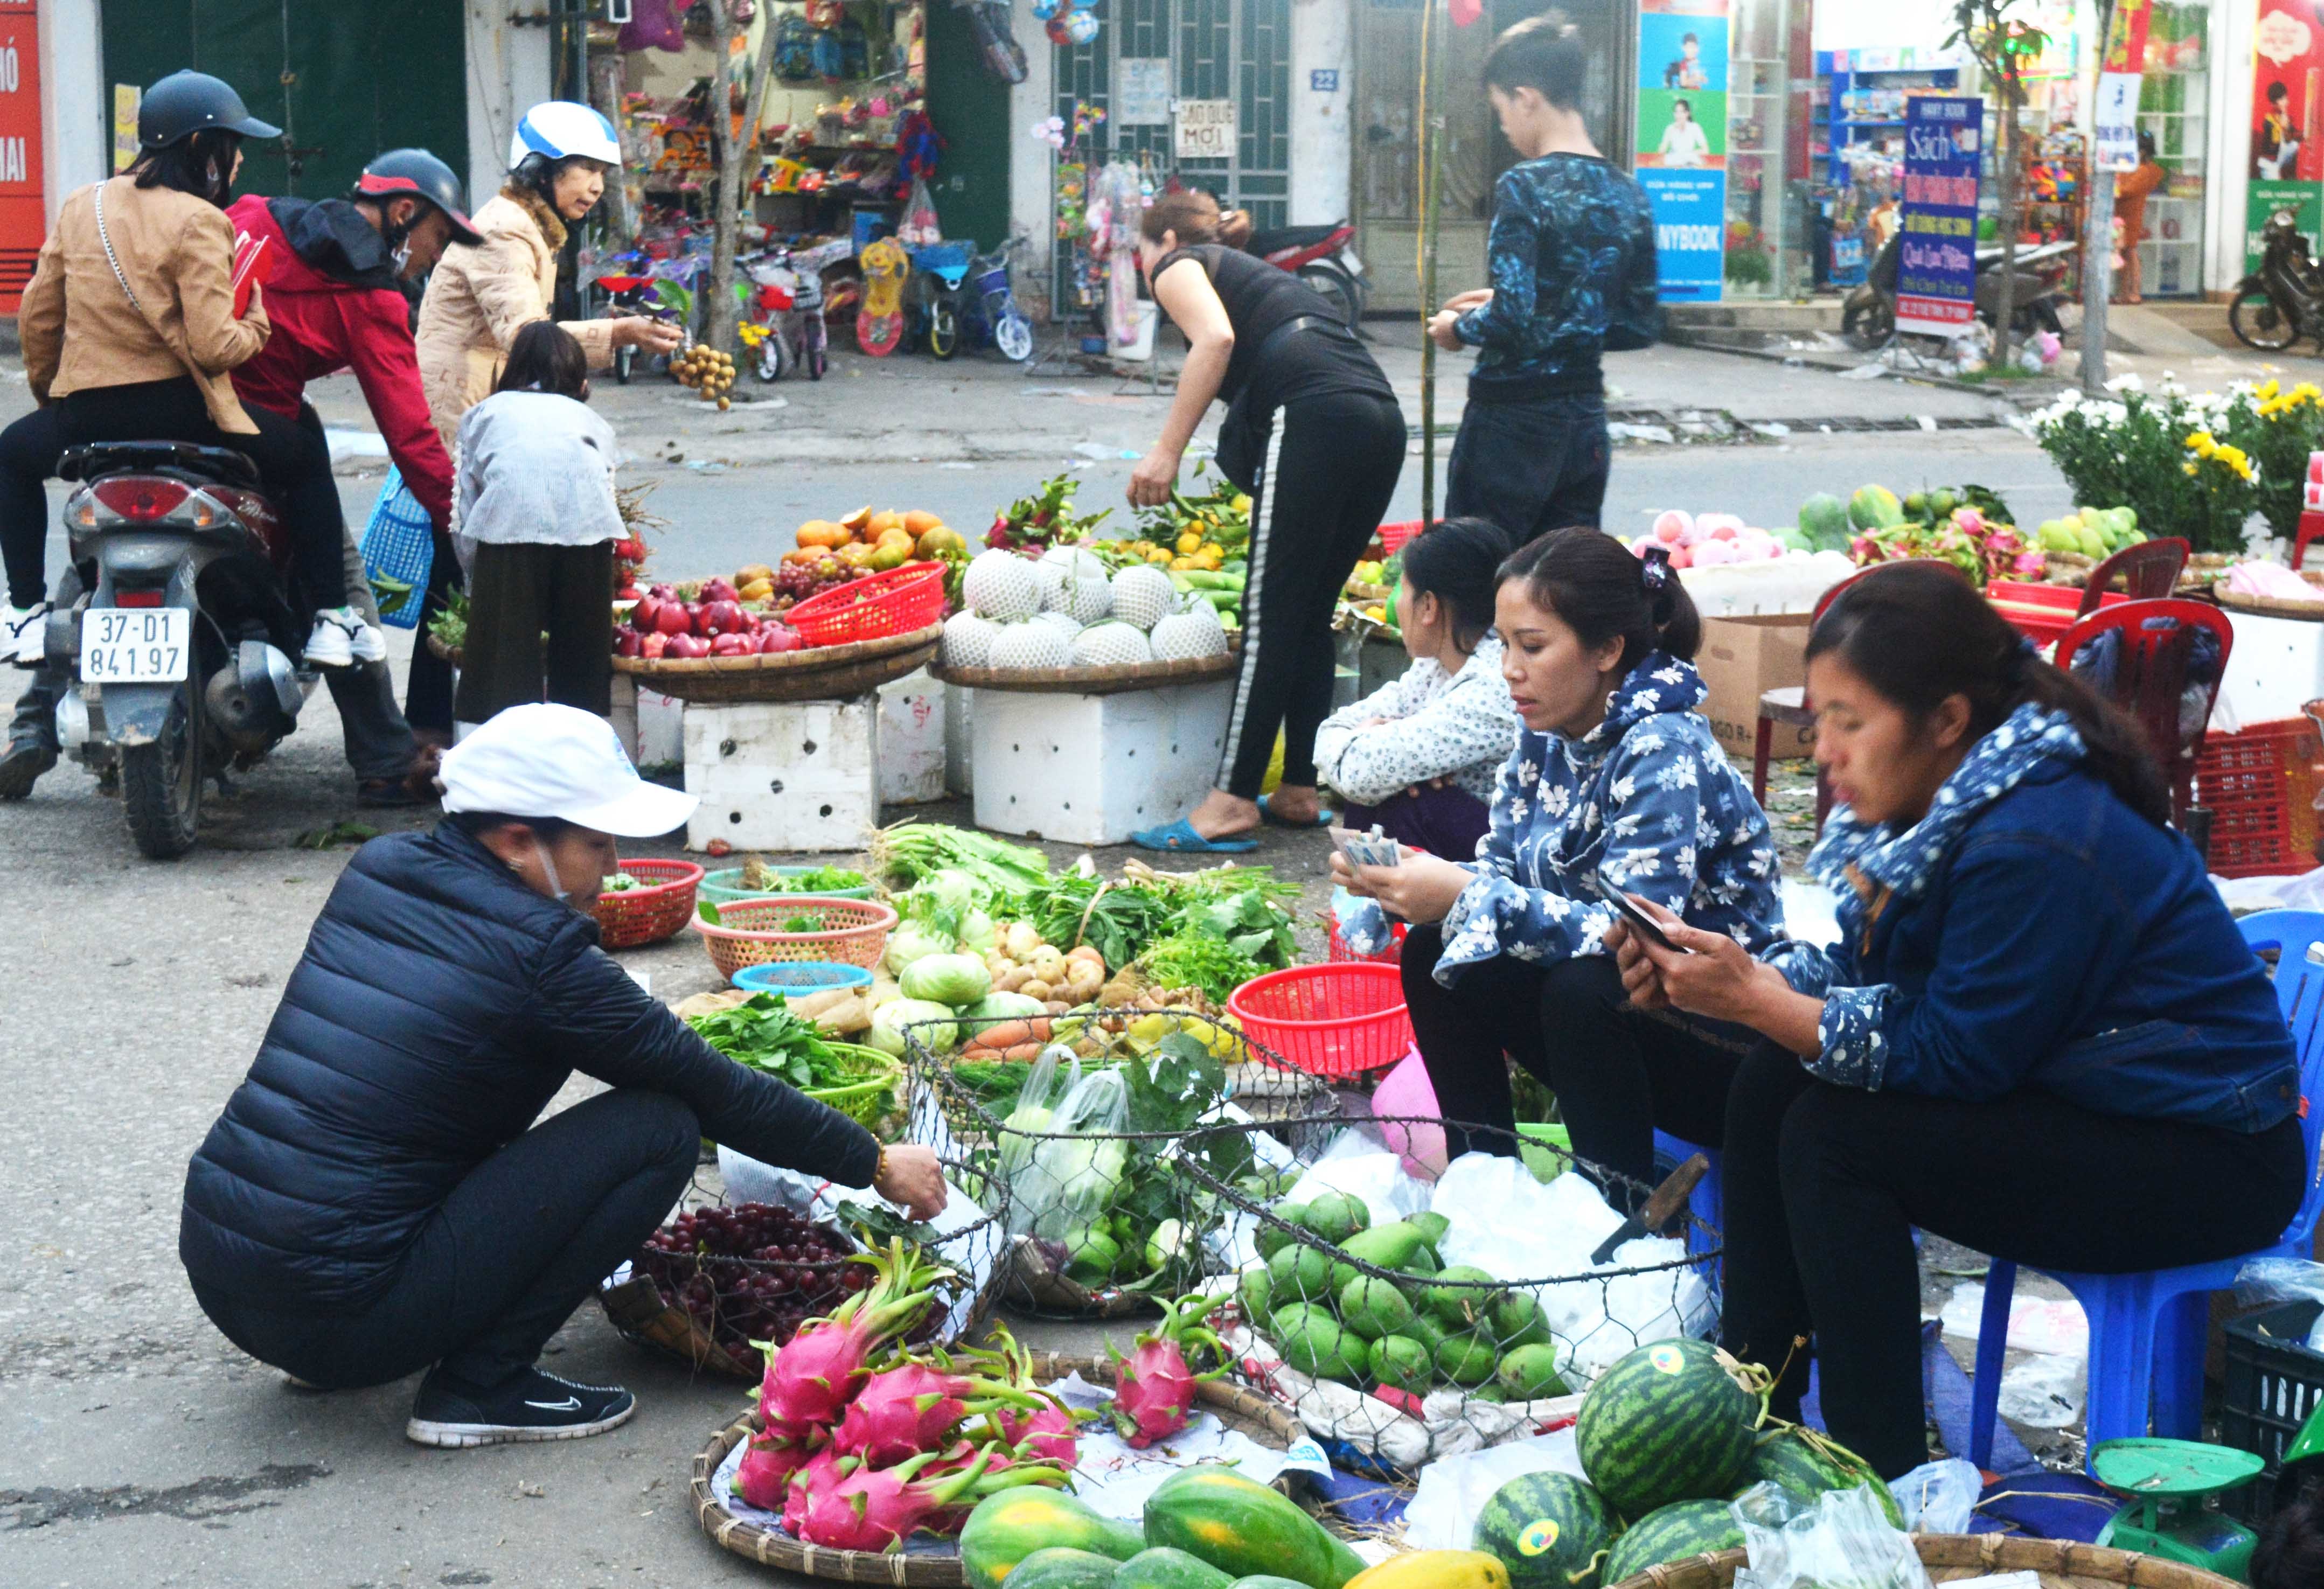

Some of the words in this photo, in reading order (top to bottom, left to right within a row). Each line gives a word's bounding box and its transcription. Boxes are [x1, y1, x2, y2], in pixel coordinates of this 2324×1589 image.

[1312, 71, 1333, 88] 22
[1909, 126, 1950, 161] Sách
[100, 615, 169, 643] 37-D1
[90, 647, 179, 676] 841.97
